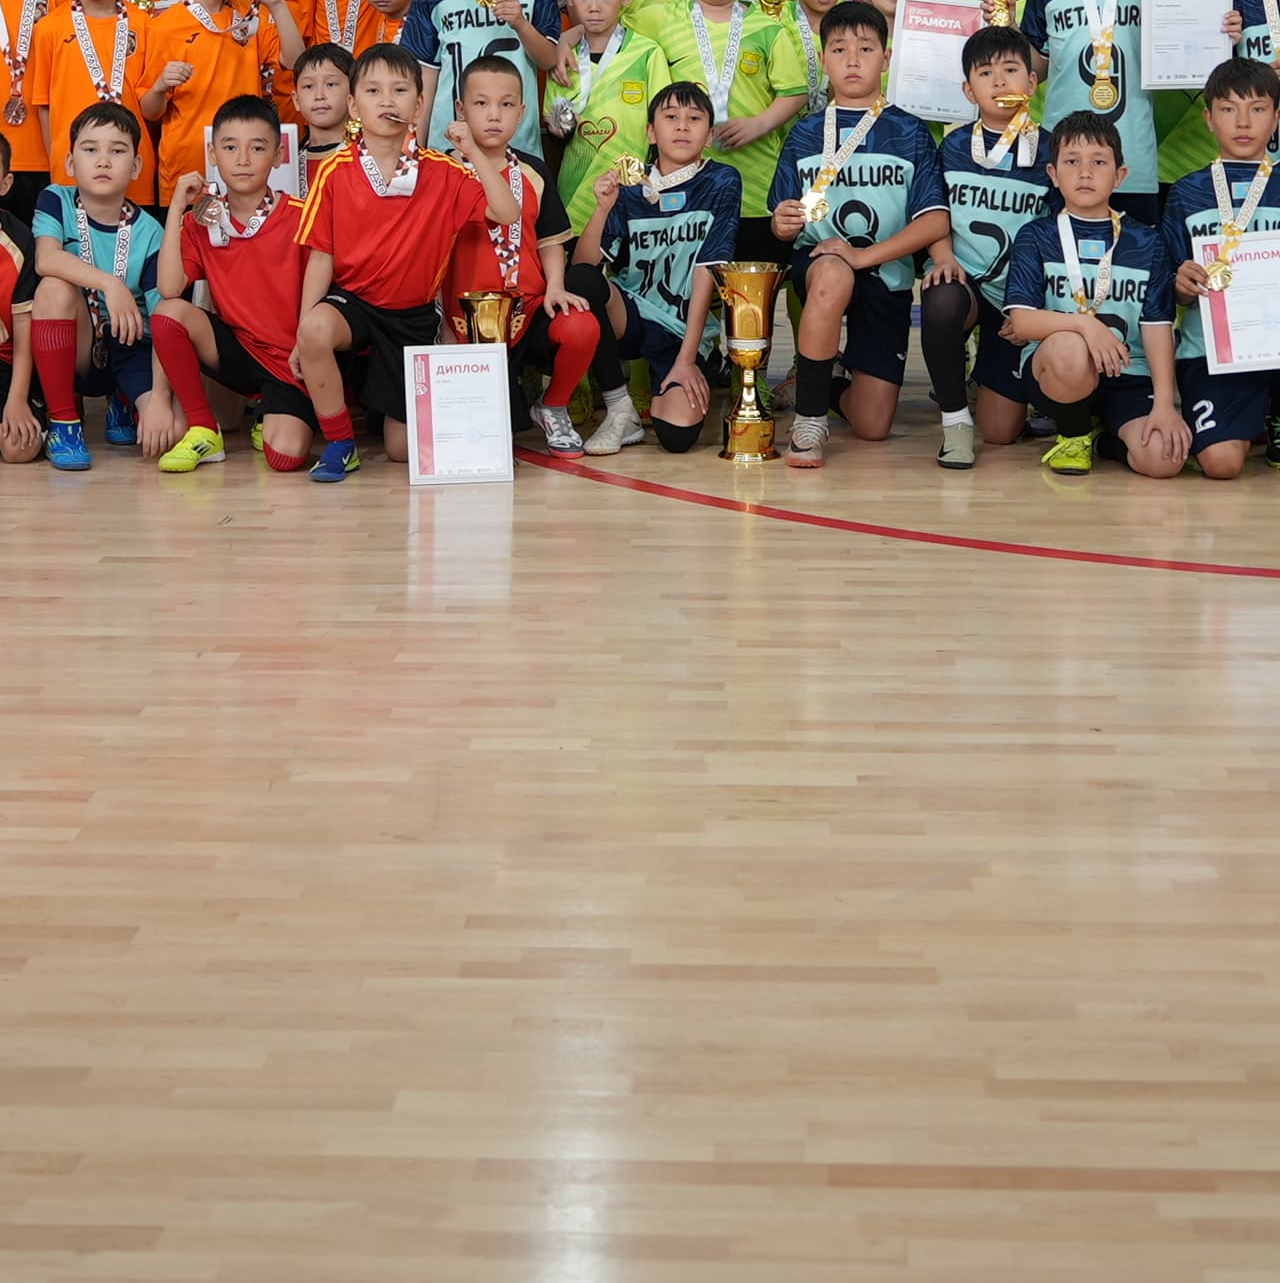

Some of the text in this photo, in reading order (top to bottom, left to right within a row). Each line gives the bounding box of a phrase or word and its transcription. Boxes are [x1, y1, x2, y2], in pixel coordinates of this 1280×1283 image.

[908, 15, 962, 30] ГРАМОТА
[1078, 40, 1127, 121] 9
[800, 166, 904, 188] MALLURG
[436, 364, 490, 375] ДИПЛОМ
[1192, 399, 1217, 433] 2
